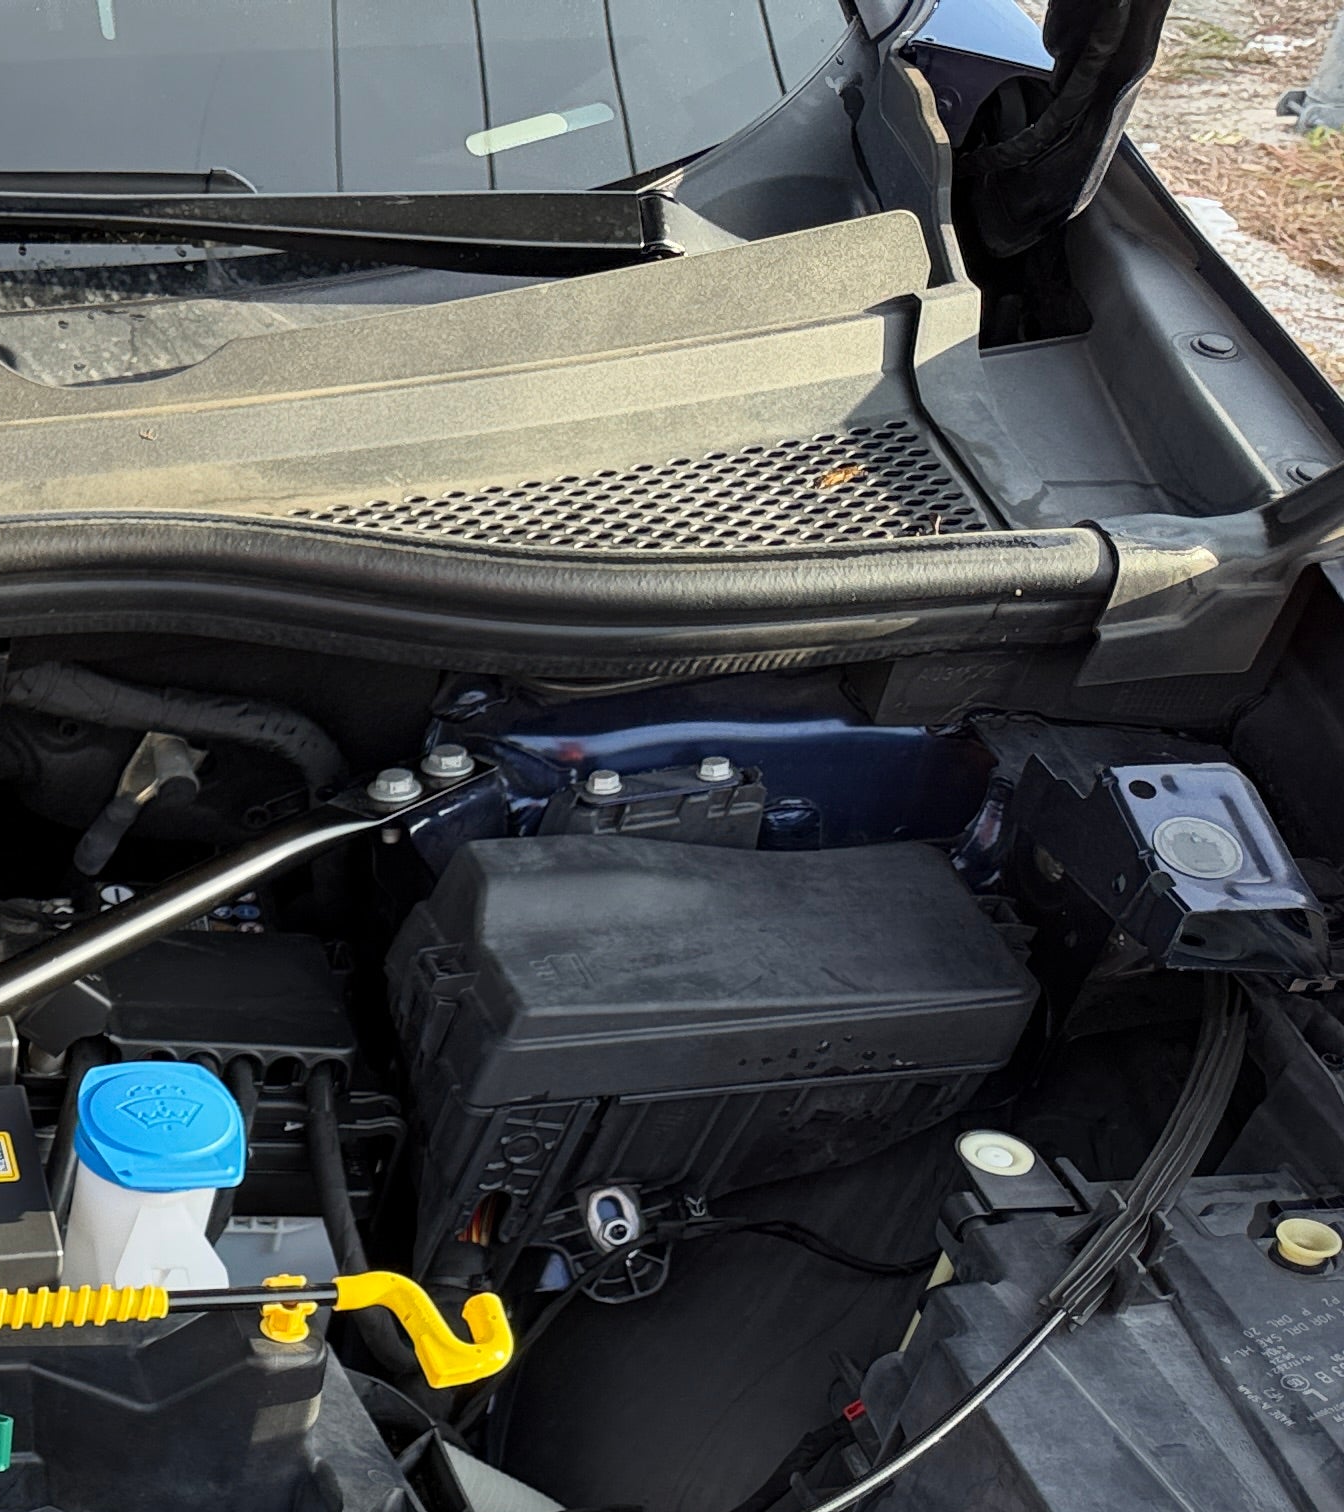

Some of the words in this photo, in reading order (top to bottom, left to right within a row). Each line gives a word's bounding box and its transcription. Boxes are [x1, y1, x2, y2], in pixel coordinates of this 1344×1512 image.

[1266, 1314, 1293, 1328] DRL
[1310, 1312, 1336, 1326] VOR
[1282, 1322, 1310, 1336] DRL
[1255, 1333, 1282, 1348] SAE
[1314, 1371, 1334, 1384] B
[1302, 1388, 1329, 1402] L
